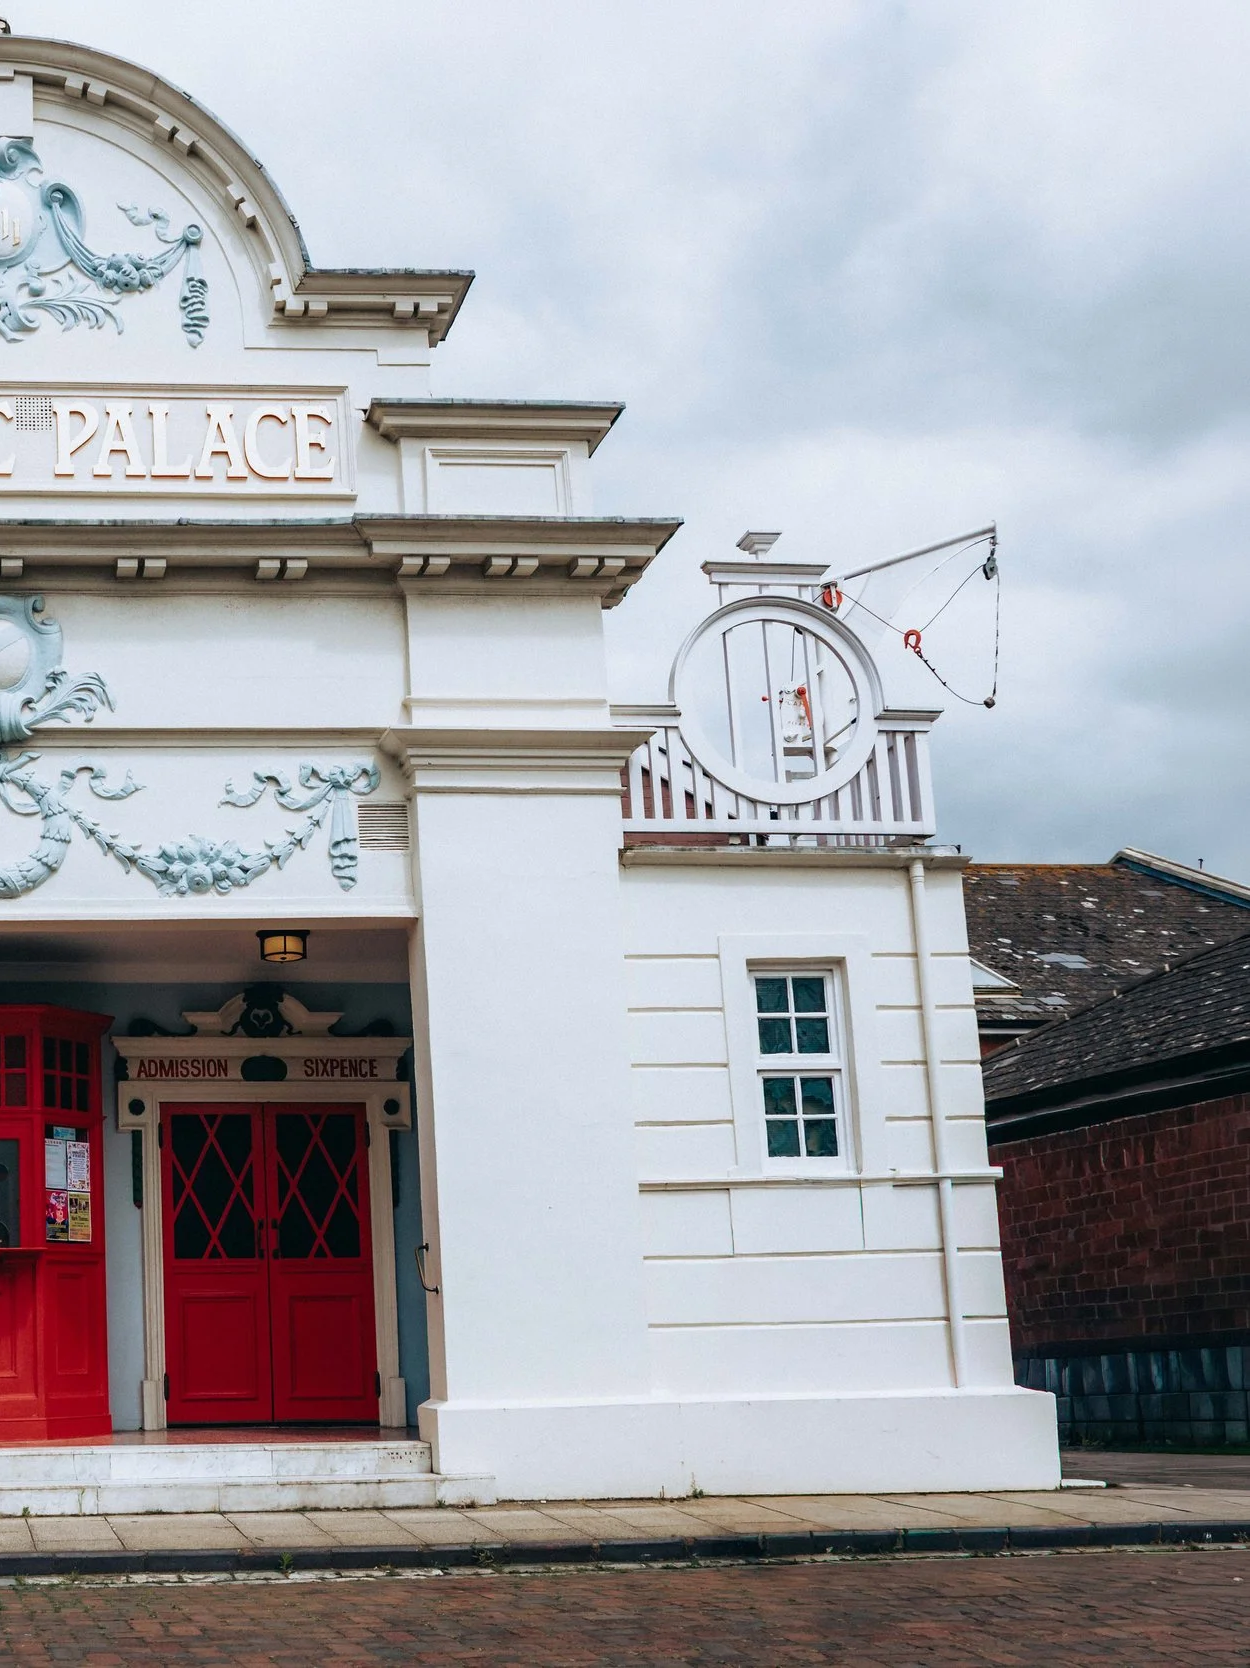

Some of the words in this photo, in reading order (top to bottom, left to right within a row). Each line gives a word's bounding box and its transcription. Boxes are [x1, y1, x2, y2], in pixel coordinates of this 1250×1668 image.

[52, 400, 335, 479] PALACE
[136, 1059, 228, 1078] ADMISSION
[304, 1058, 379, 1078] SIXPENCE
